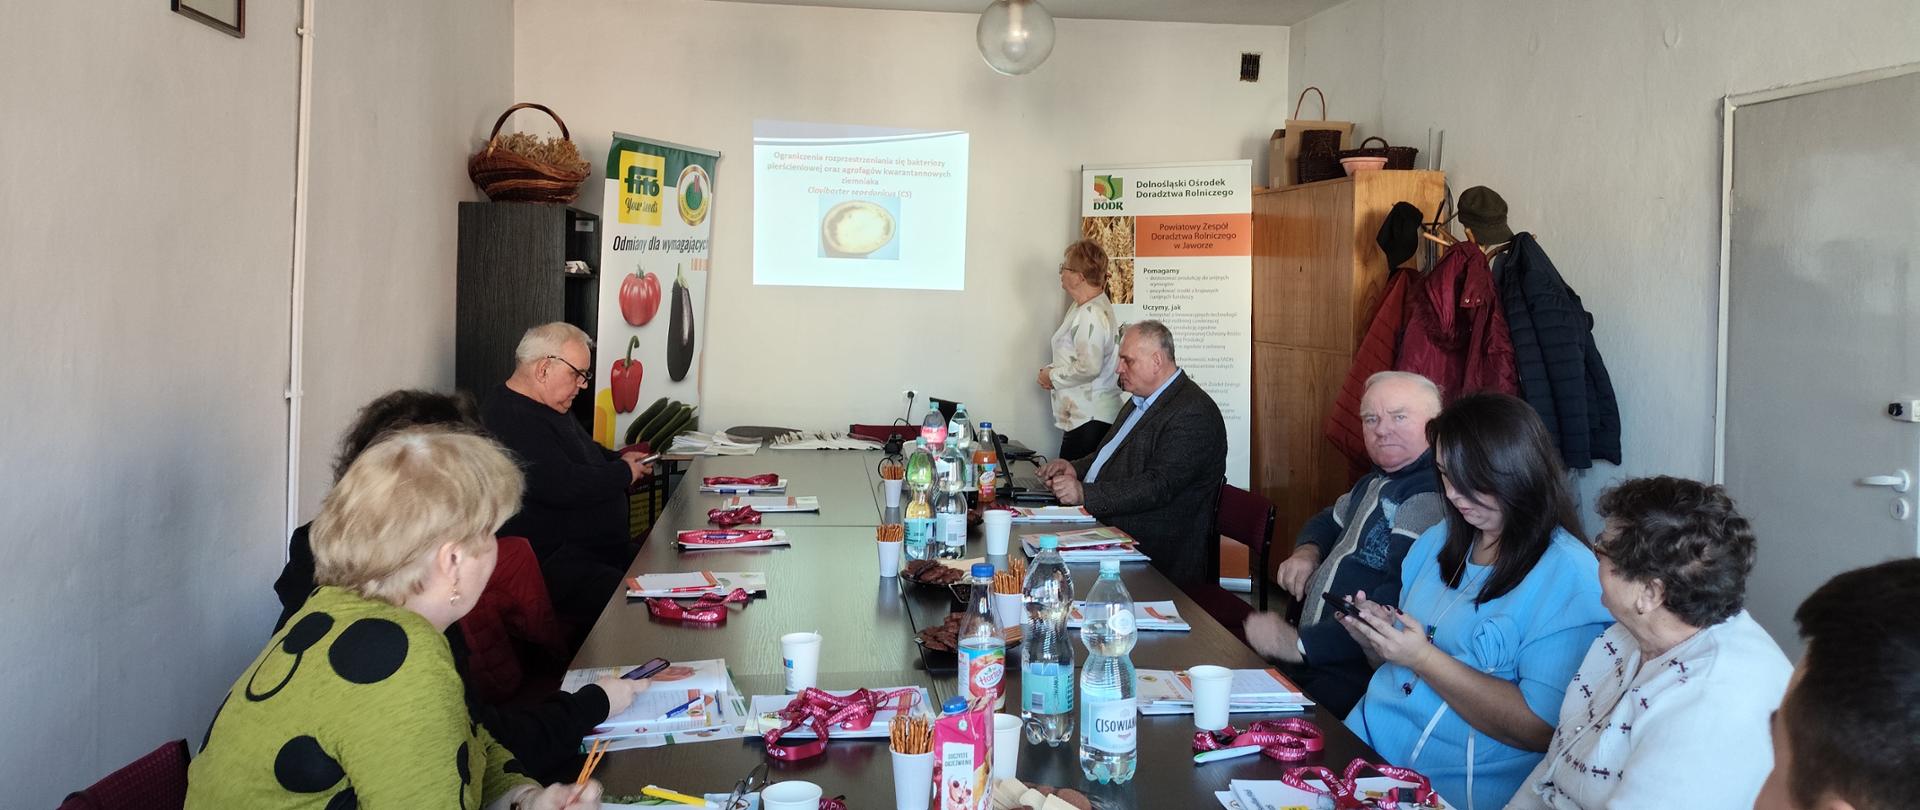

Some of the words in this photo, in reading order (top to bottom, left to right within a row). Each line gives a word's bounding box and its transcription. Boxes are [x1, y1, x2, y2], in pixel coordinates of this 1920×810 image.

[1136, 179, 1186, 190] Dolnośląski
[1188, 178, 1226, 187] Ośrodek
[1136, 190, 1183, 199] Doradztwa
[1185, 188, 1234, 198] Rolniczego
[1093, 202, 1124, 211] DODR
[1159, 223, 1201, 233] Powiatowy
[1202, 222, 1229, 232] Zespół
[1151, 232, 1193, 241] Doradztwa
[1194, 231, 1237, 241] Rolniczego
[613, 235, 647, 254] Odmiany
[648, 236, 661, 251] dla
[1182, 241, 1214, 250] Jaworze
[1143, 267, 1179, 276] Pomagamy
[1142, 304, 1170, 312] Uczymy,
[1170, 304, 1182, 312] jak
